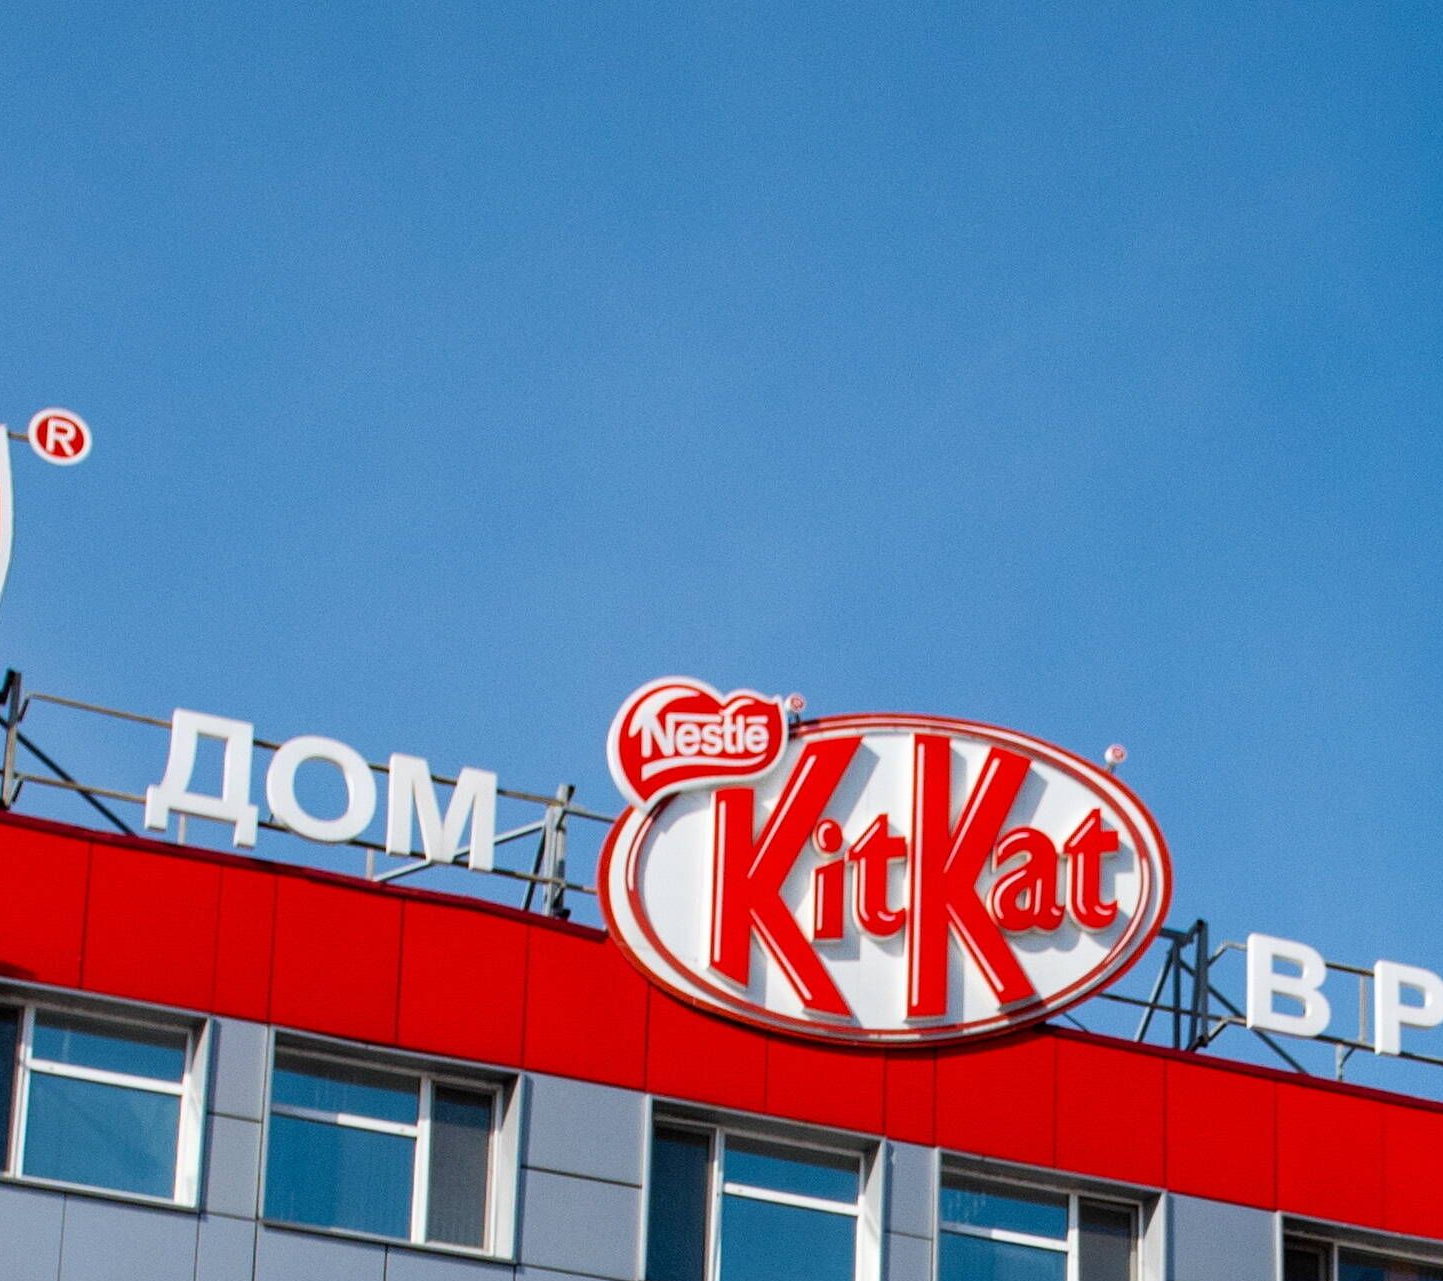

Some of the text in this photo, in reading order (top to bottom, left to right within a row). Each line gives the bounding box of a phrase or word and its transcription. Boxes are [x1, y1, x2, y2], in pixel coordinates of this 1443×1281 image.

[145, 708, 497, 872] ДОМ
[706, 733, 1122, 1020] KitKat
[1246, 933, 1330, 1038] В
